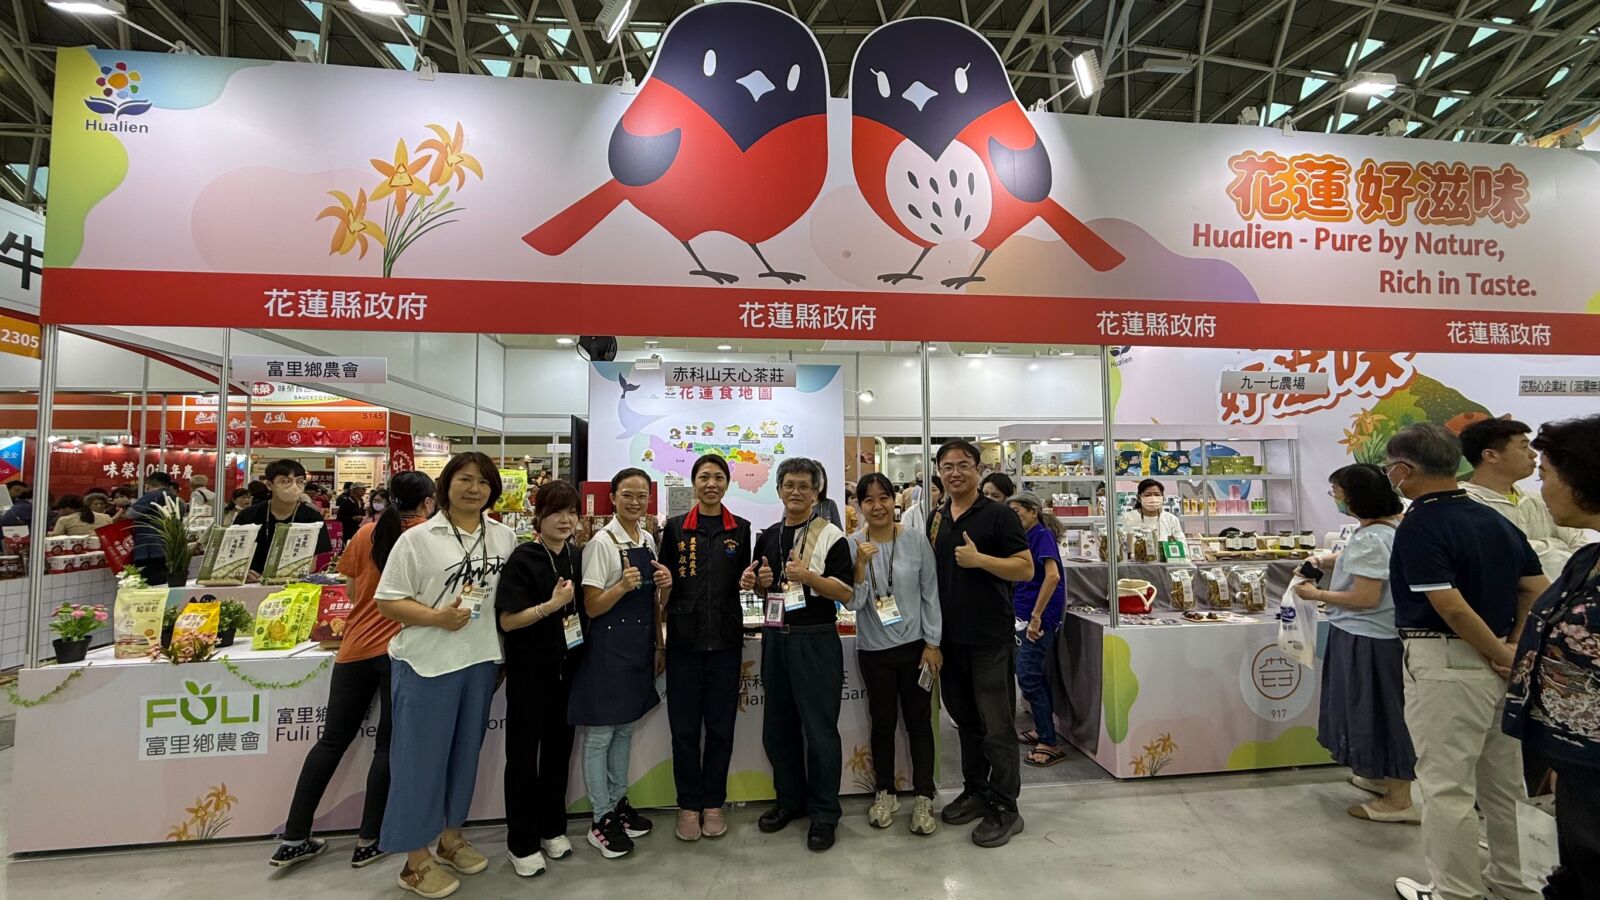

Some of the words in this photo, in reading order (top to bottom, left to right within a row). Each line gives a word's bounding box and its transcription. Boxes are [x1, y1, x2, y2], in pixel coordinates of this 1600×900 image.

[85, 119, 149, 134] Hualien
[1192, 223, 1293, 250] Hualien
[1314, 227, 1372, 253] Pure
[1378, 228, 1408, 260] by
[1414, 231, 1506, 262] Nature,
[1379, 270, 1432, 295] Rich
[1438, 270, 1460, 295] in
[1465, 271, 1537, 297] Taste.
[263, 288, 428, 321] 花蓮縣政府
[738, 301, 877, 331] 花蓮縣政府
[1096, 310, 1217, 338] 花蓮縣政府
[1446, 320, 1552, 346] 花蓮縣政府
[266, 361, 360, 379] 富里鄉農會
[672, 366, 785, 383] 赤科山天心茶莊
[679, 385, 773, 401] 花蓮食地圖
[1240, 375, 1306, 391] 九一七農場
[146, 693, 260, 728] FULI
[1271, 709, 1287, 719] 917
[145, 732, 261, 757] 富里鄉農會
[276, 726, 310, 742] Fuli
